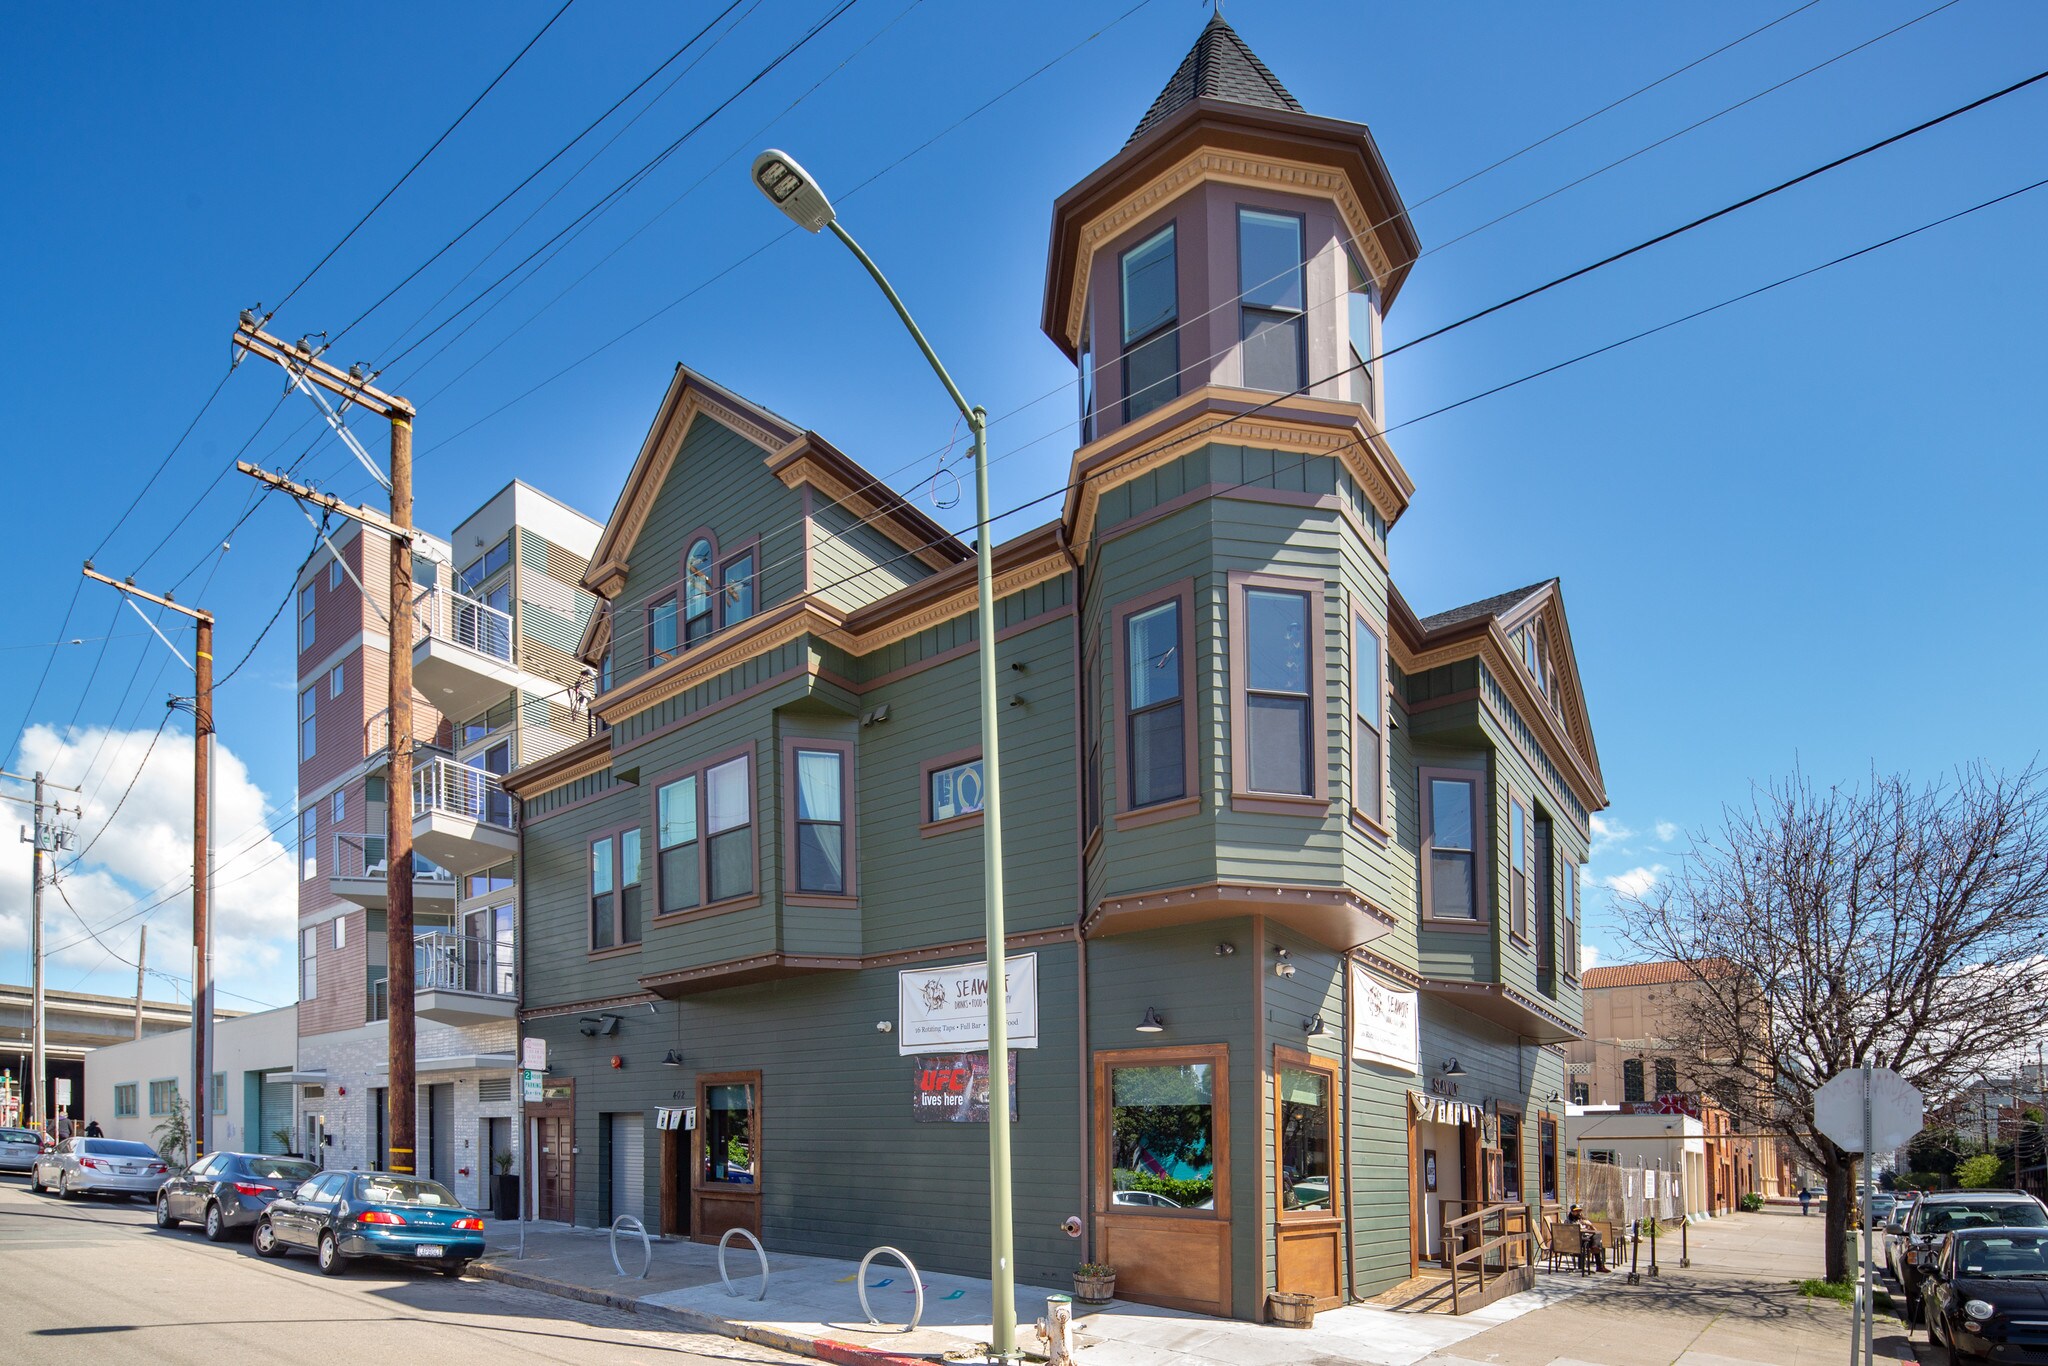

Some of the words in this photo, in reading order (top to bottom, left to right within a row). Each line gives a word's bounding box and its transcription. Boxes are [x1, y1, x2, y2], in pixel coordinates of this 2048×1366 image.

[956, 974, 1010, 998] SEAWF
[972, 999, 982, 1008] FOOD
[921, 1024, 941, 1034] Rotating
[943, 1023, 956, 1034] Taps
[960, 1023, 971, 1031] Full
[971, 1022, 981, 1030] Bar
[525, 1071, 531, 1079] 2
[921, 1069, 965, 1090] UFC
[921, 1092, 942, 1107] lives
[944, 1092, 964, 1106] here
